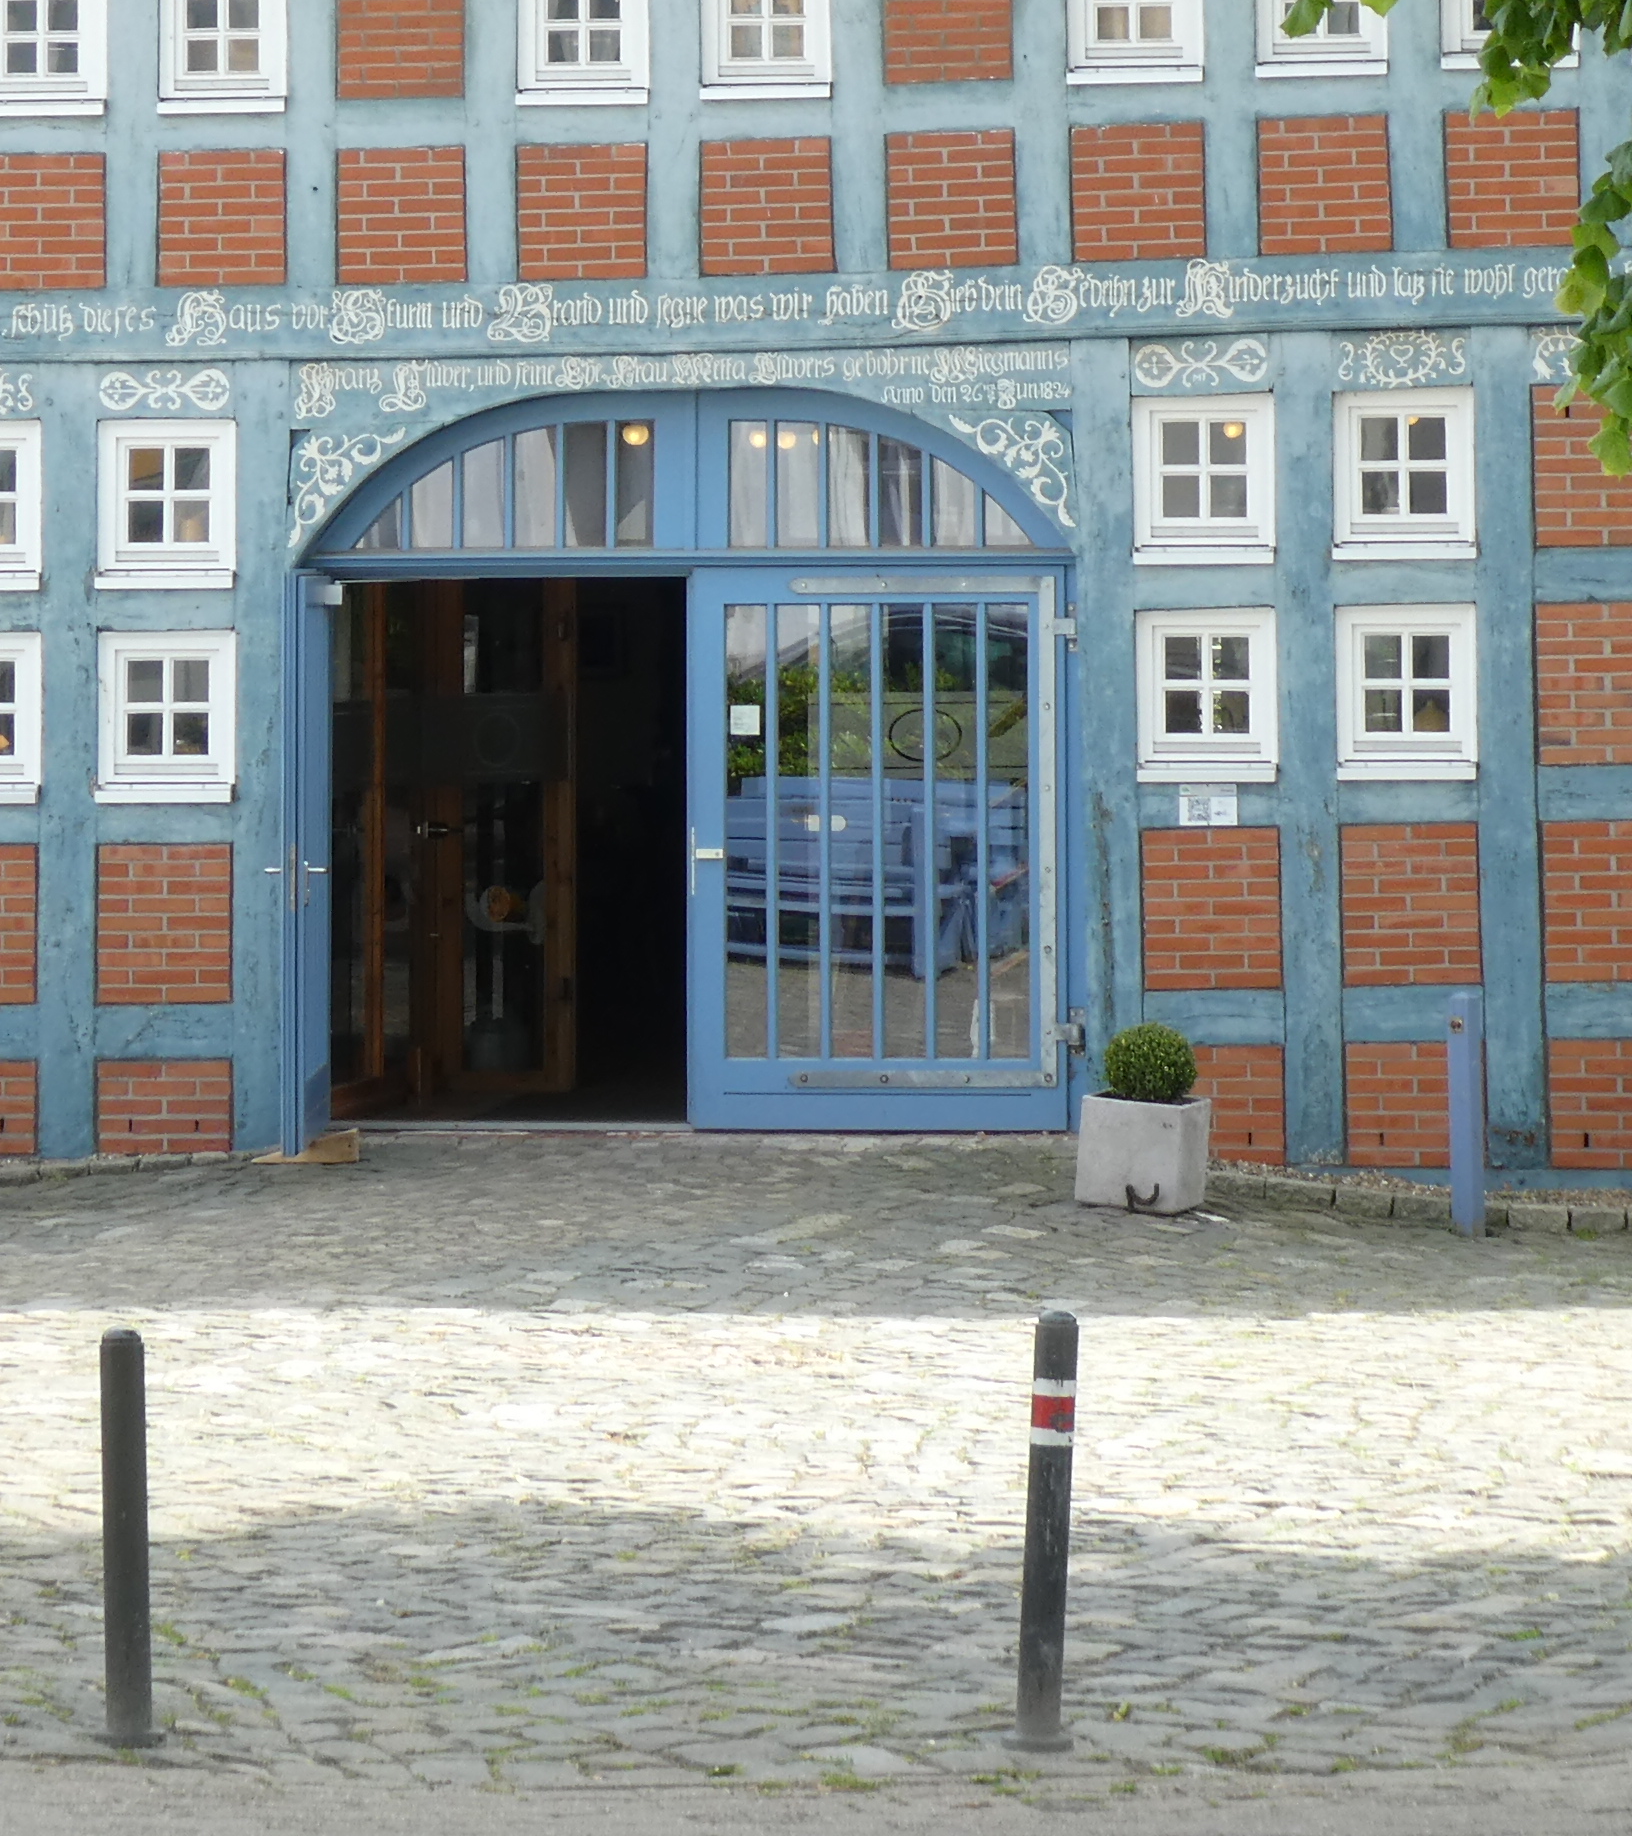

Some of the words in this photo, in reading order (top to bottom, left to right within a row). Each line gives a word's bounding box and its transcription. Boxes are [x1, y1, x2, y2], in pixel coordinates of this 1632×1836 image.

[79, 301, 156, 338] dieses
[165, 288, 280, 347] Haus
[291, 304, 329, 330] vor
[329, 288, 433, 345] Sturm
[442, 294, 483, 330] und
[486, 282, 602, 343] Brand
[609, 290, 648, 325] und
[656, 290, 708, 329] segne
[715, 292, 763, 325] was
[769, 290, 812, 321] wir
[818, 284, 888, 326] haben
[978, 275, 1022, 312] dein
[1023, 265, 1136, 325] Gedeihn
[1137, 276, 1175, 312] zur
[1348, 264, 1386, 299] und
[1432, 263, 1454, 297] sie
[1465, 264, 1515, 300] wohl
[477, 360, 511, 386] und
[514, 361, 555, 390] seine
[881, 385, 923, 404] Anno
[929, 383, 956, 403] den
